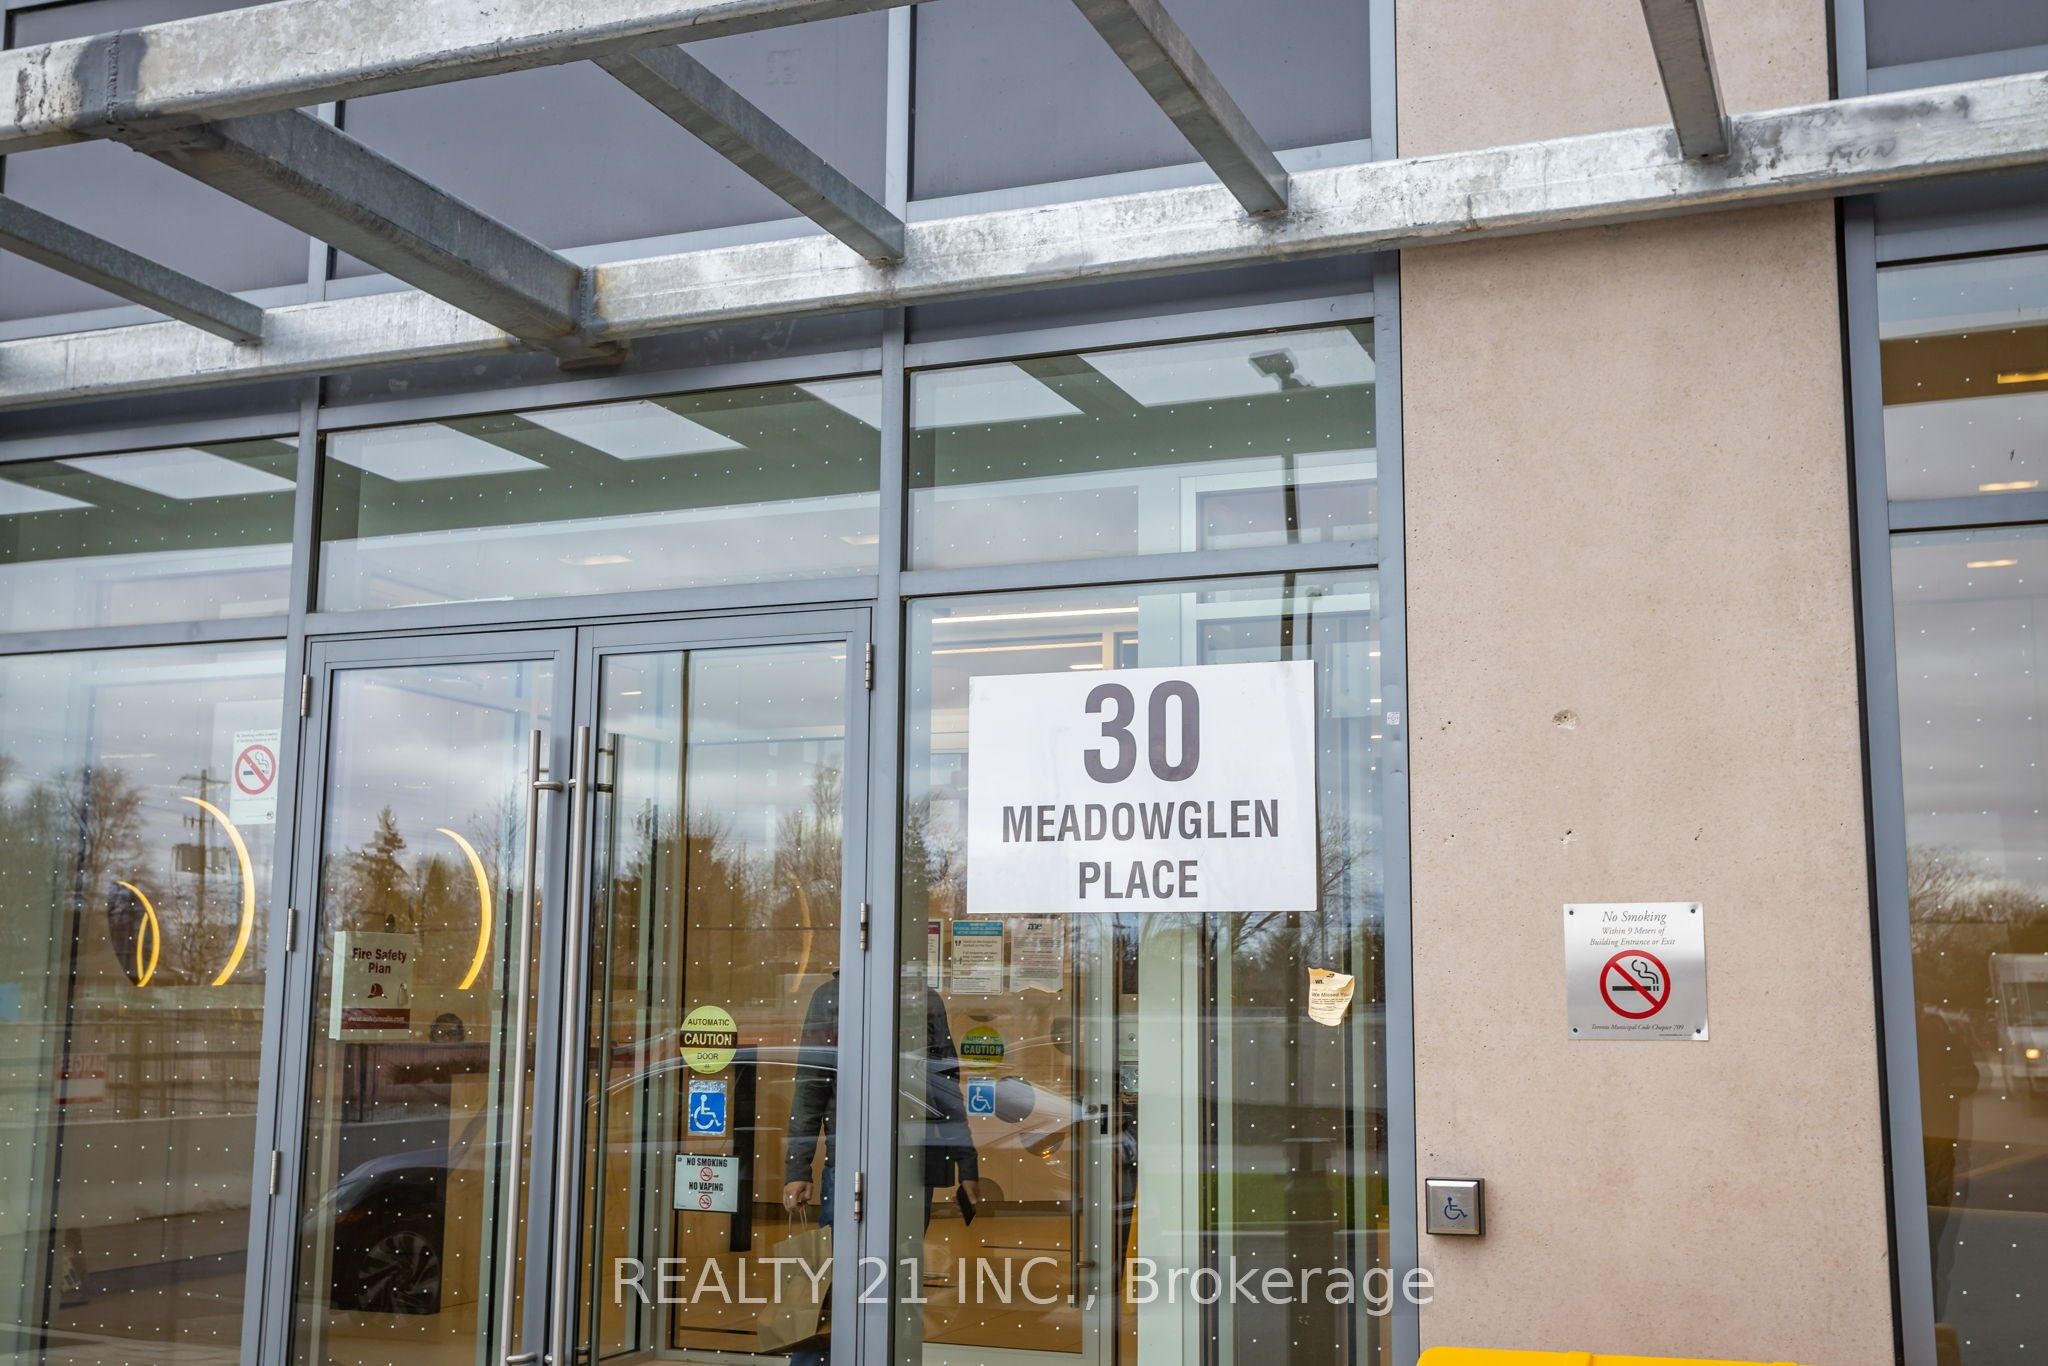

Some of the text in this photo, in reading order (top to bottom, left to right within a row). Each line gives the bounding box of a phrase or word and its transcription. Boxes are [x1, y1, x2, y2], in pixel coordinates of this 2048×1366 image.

[1083, 680, 1200, 784] 30
[1002, 799, 1279, 843] MEADOWGLEN
[1078, 859, 1199, 900] PLACE
[1602, 909, 1667, 925] No Smoking
[1602, 925, 1666, 936] Within 9 Meters of
[1589, 937, 1619, 947] Building
[1620, 938, 1650, 946] Entrance
[1661, 937, 1676, 945] Exit
[352, 947, 407, 964] Fire Safety
[368, 962, 391, 974] Plan
[687, 1018, 730, 1026] AUTOMATIC
[684, 1032, 732, 1046] CAUTION
[963, 1044, 1002, 1056] CAUTION
[696, 1052, 719, 1061] DOOR
[686, 1157, 728, 1167] NO SMOKING
[688, 1181, 724, 1191] NO VAPING
